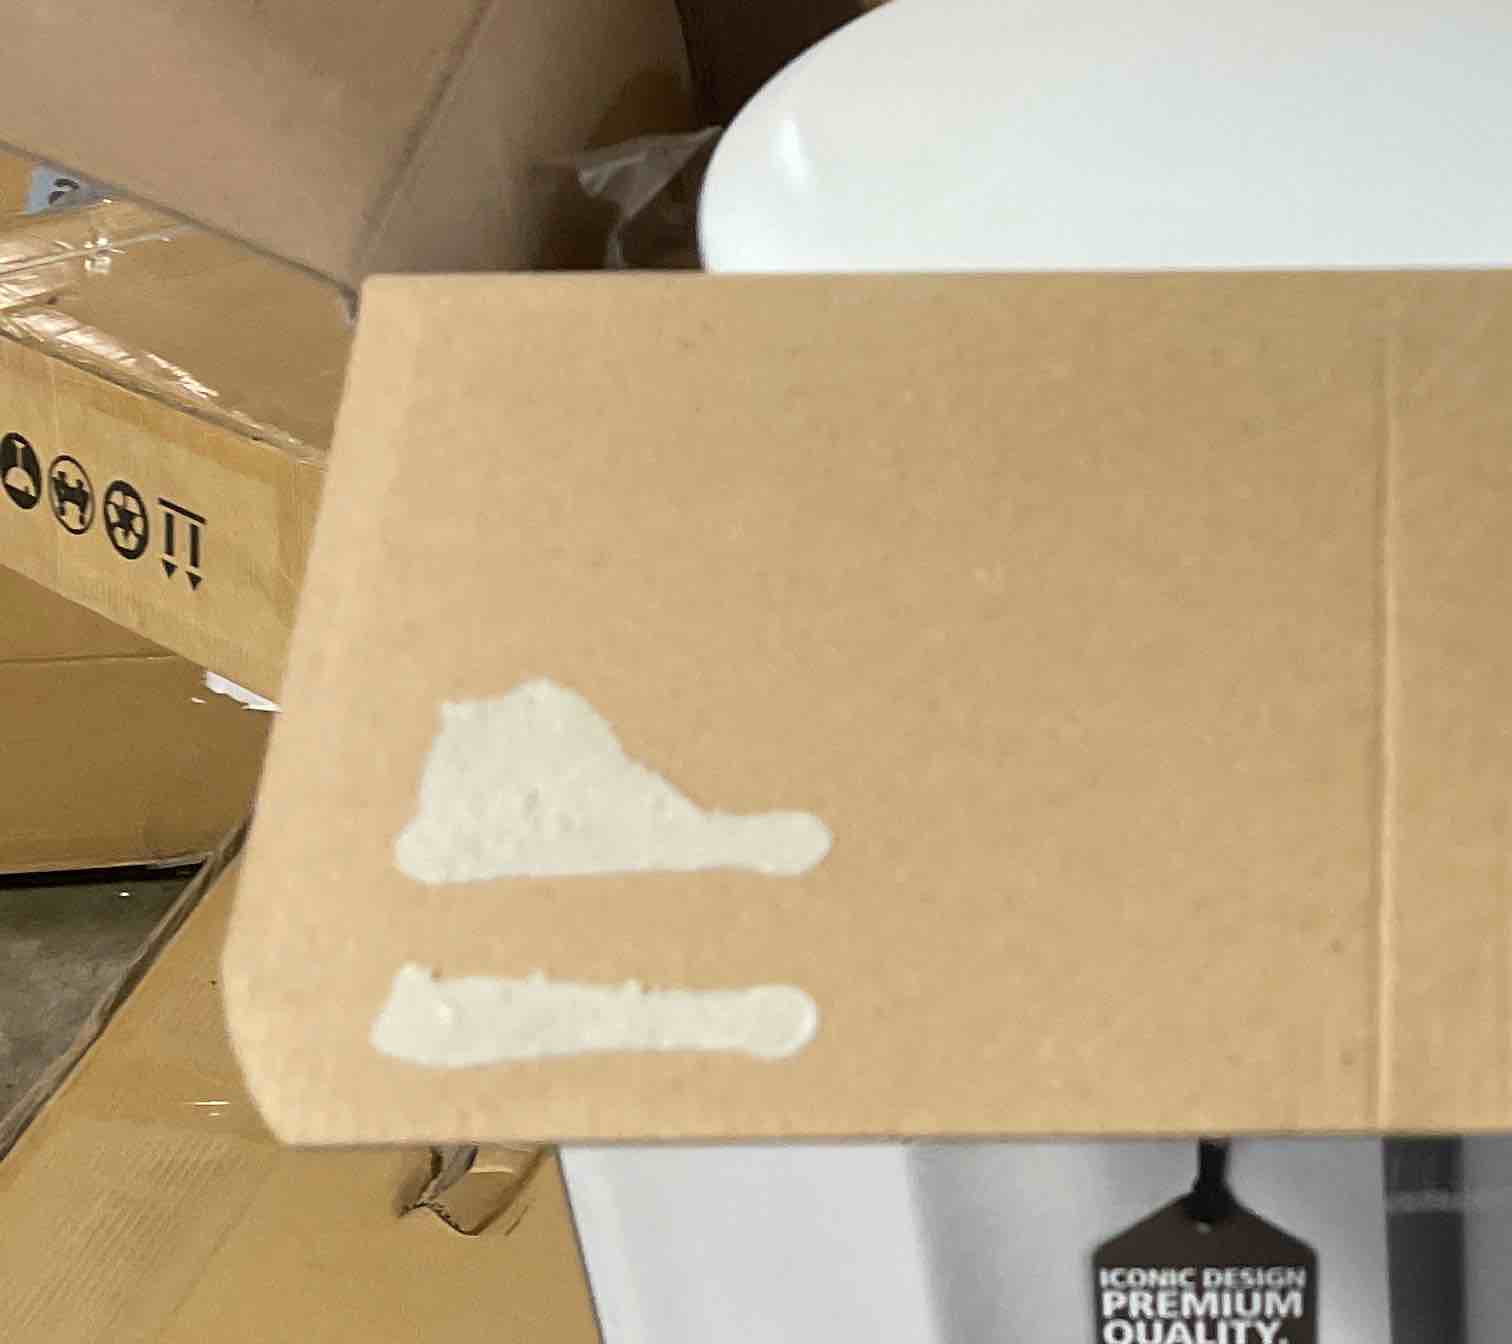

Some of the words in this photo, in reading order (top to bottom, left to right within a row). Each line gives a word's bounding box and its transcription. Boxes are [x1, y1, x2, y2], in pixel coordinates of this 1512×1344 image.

[1100, 1266, 1197, 1288] ICONIC
[1202, 1266, 1307, 1289] DESIGN
[1102, 1289, 1304, 1319] PREMIUM
